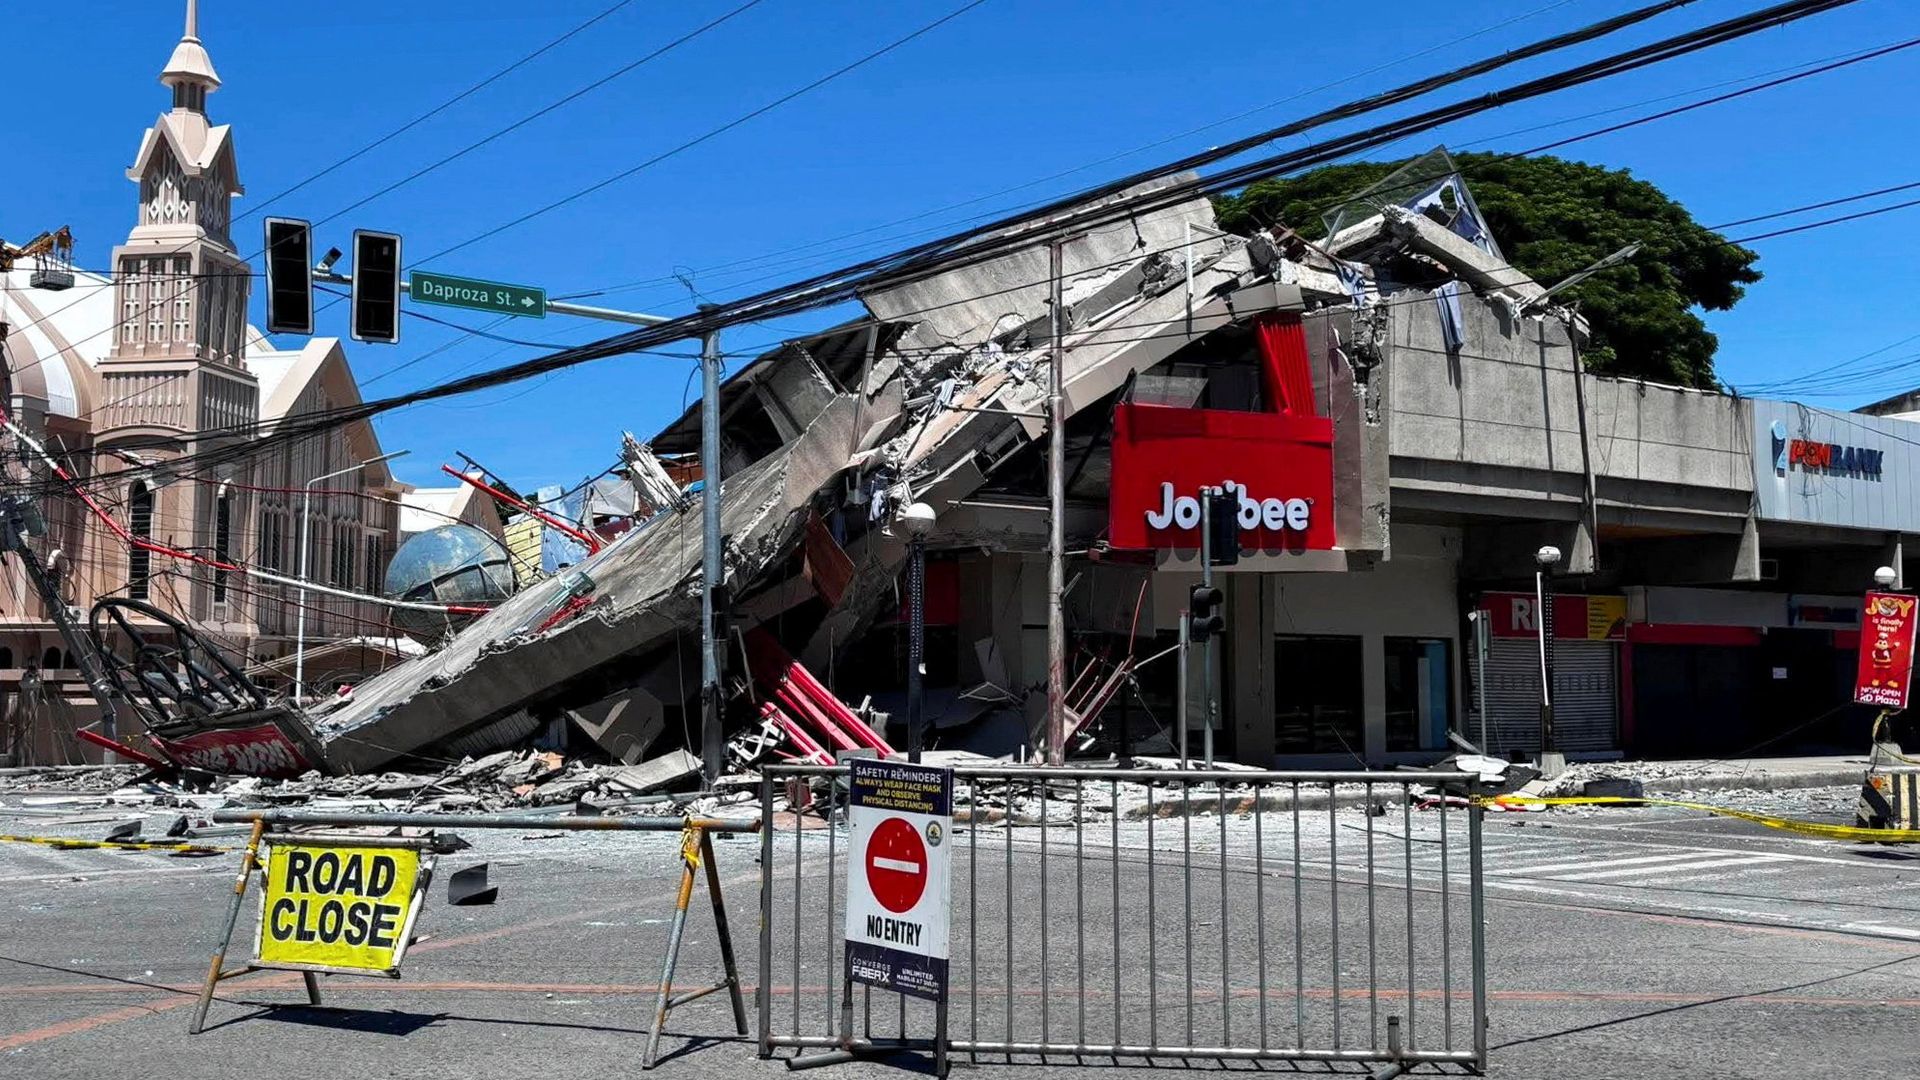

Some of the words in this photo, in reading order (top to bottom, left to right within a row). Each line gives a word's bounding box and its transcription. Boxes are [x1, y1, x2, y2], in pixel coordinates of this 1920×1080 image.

[422, 280, 489, 303] Daproza
[495, 291, 515, 306] St.
[1145, 480, 1311, 531] Jobee
[1877, 624, 1898, 633] here!
[1880, 617, 1904, 628] finally
[1860, 686, 1880, 695] NOW
[1881, 688, 1902, 697] OPEN
[856, 766, 888, 778] SAFETY
[890, 770, 942, 784] REMINDERS
[856, 777, 883, 787] ALWAYS
[884, 780, 904, 789] WEAR
[904, 783, 922, 792] FACE
[922, 784, 942, 793] MASK
[876, 788, 890, 797] AND
[891, 789, 921, 800] OBSERVE
[863, 795, 893, 806] PHYSICAL
[894, 799, 933, 811] DISTANCING
[285, 851, 396, 898] ROAD
[270, 898, 401, 948] CLOSE
[867, 915, 882, 938] NO
[884, 918, 922, 947] ENTRY
[852, 957, 891, 972] CONVERGE
[902, 967, 934, 980] UNLIMITED
